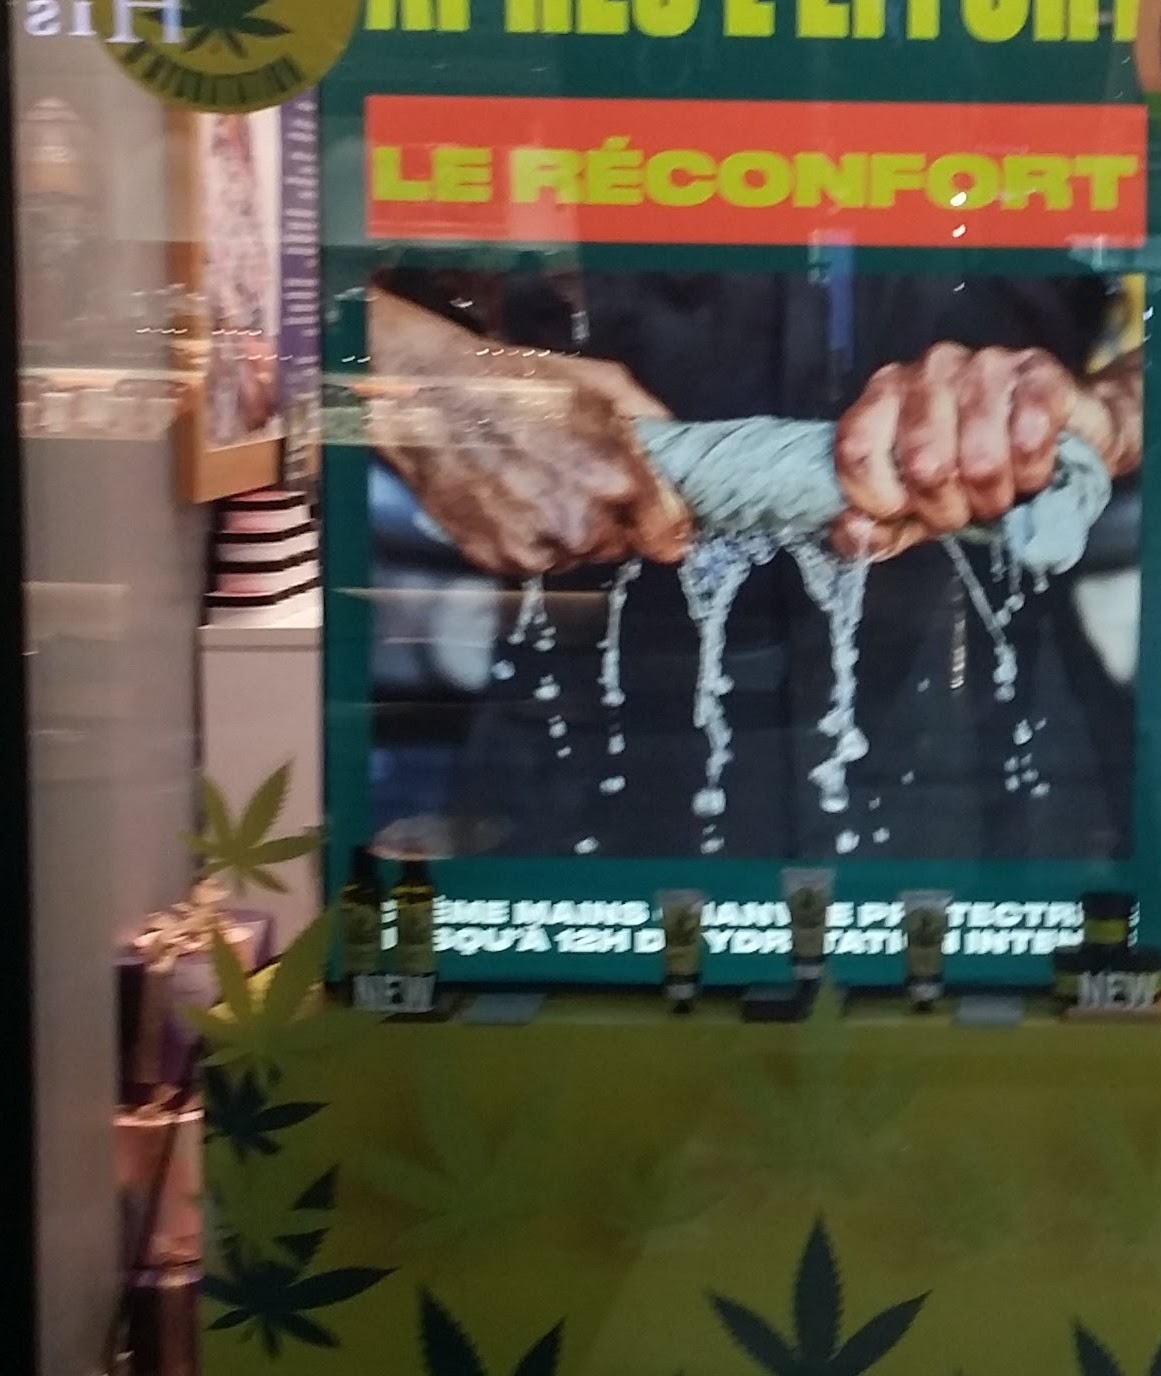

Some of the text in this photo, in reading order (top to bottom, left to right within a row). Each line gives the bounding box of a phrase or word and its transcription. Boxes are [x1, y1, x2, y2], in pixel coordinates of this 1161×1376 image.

[373, 136, 1137, 211] LE RÉCONFORT
[511, 899, 650, 926] MAINS
[554, 927, 632, 953] 12H
